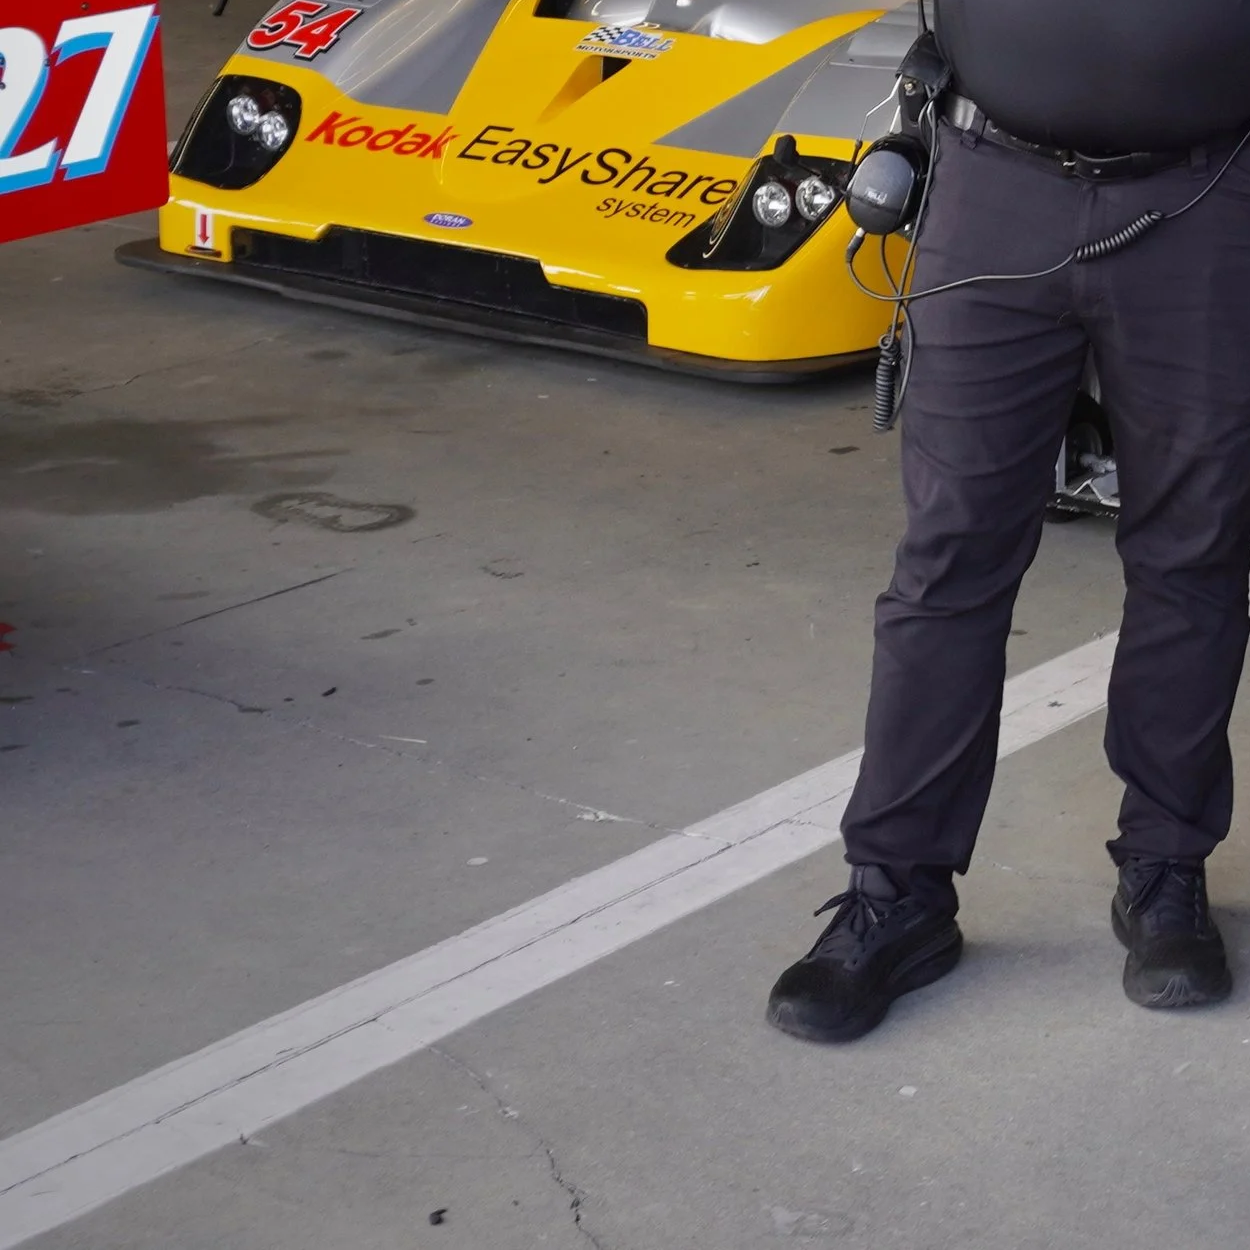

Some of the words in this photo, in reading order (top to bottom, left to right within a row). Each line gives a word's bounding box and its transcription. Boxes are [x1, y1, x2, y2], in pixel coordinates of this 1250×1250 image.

[576, 44, 657, 60] MOTORSPORTS
[608, 28, 675, 52] BELL
[0, 3, 160, 195] 27
[304, 110, 461, 160] Kodak
[456, 124, 738, 206] EasyShare
[595, 196, 697, 229] system
